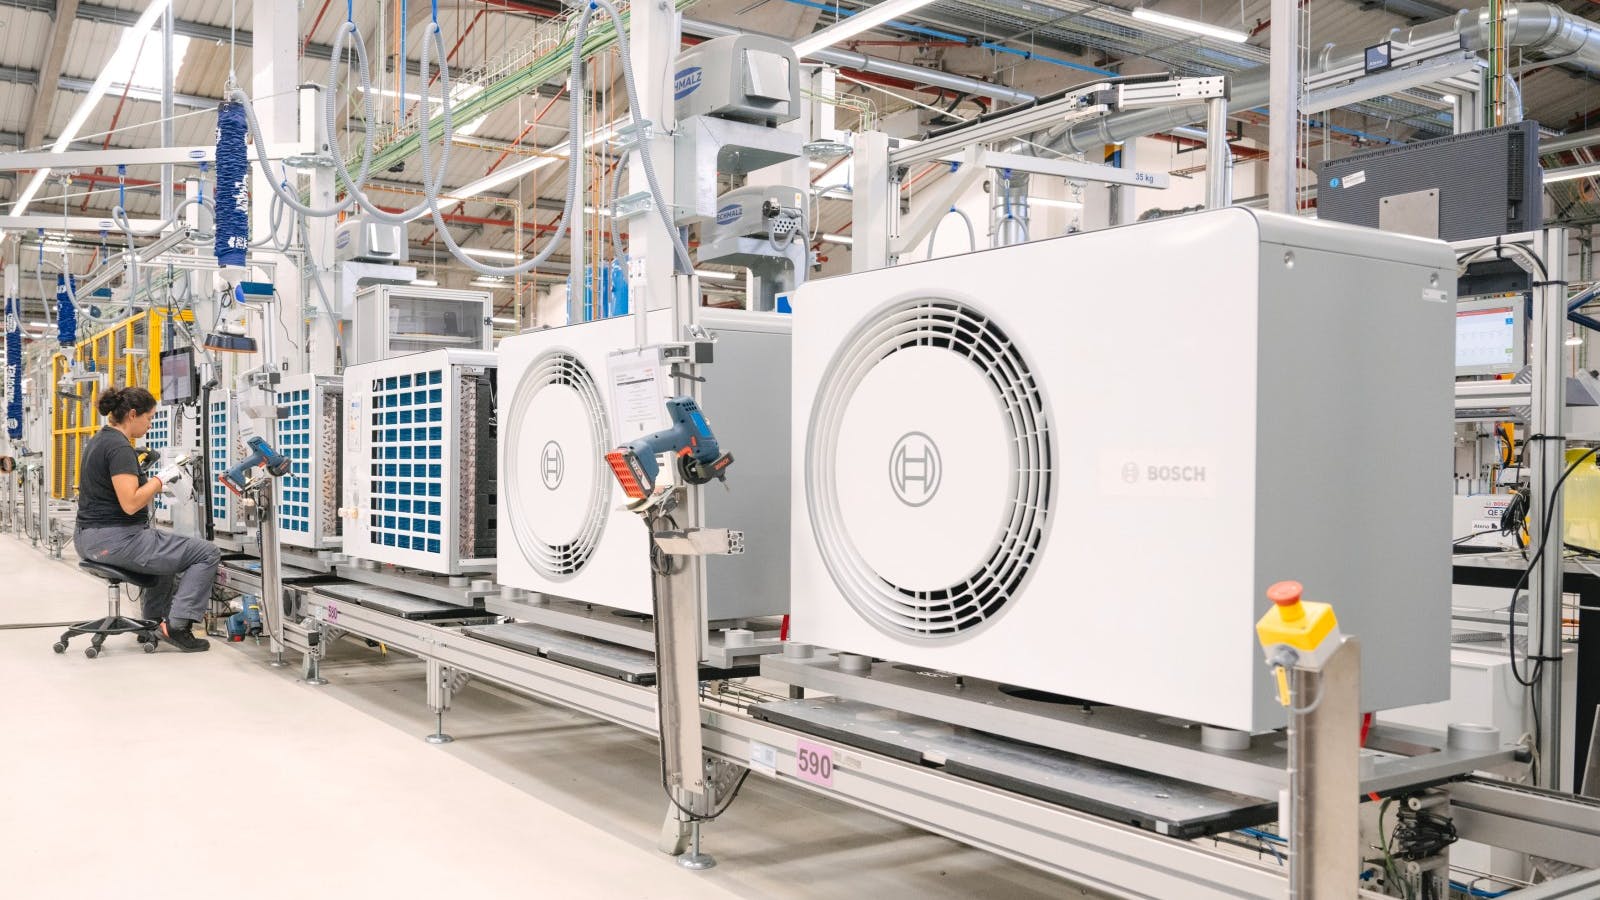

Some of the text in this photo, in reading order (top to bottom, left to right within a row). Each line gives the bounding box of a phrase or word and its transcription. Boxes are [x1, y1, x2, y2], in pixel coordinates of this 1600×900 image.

[1135, 172, 1153, 184] 35 kg
[1147, 465, 1206, 482] BOSCH
[798, 748, 831, 779] 590
